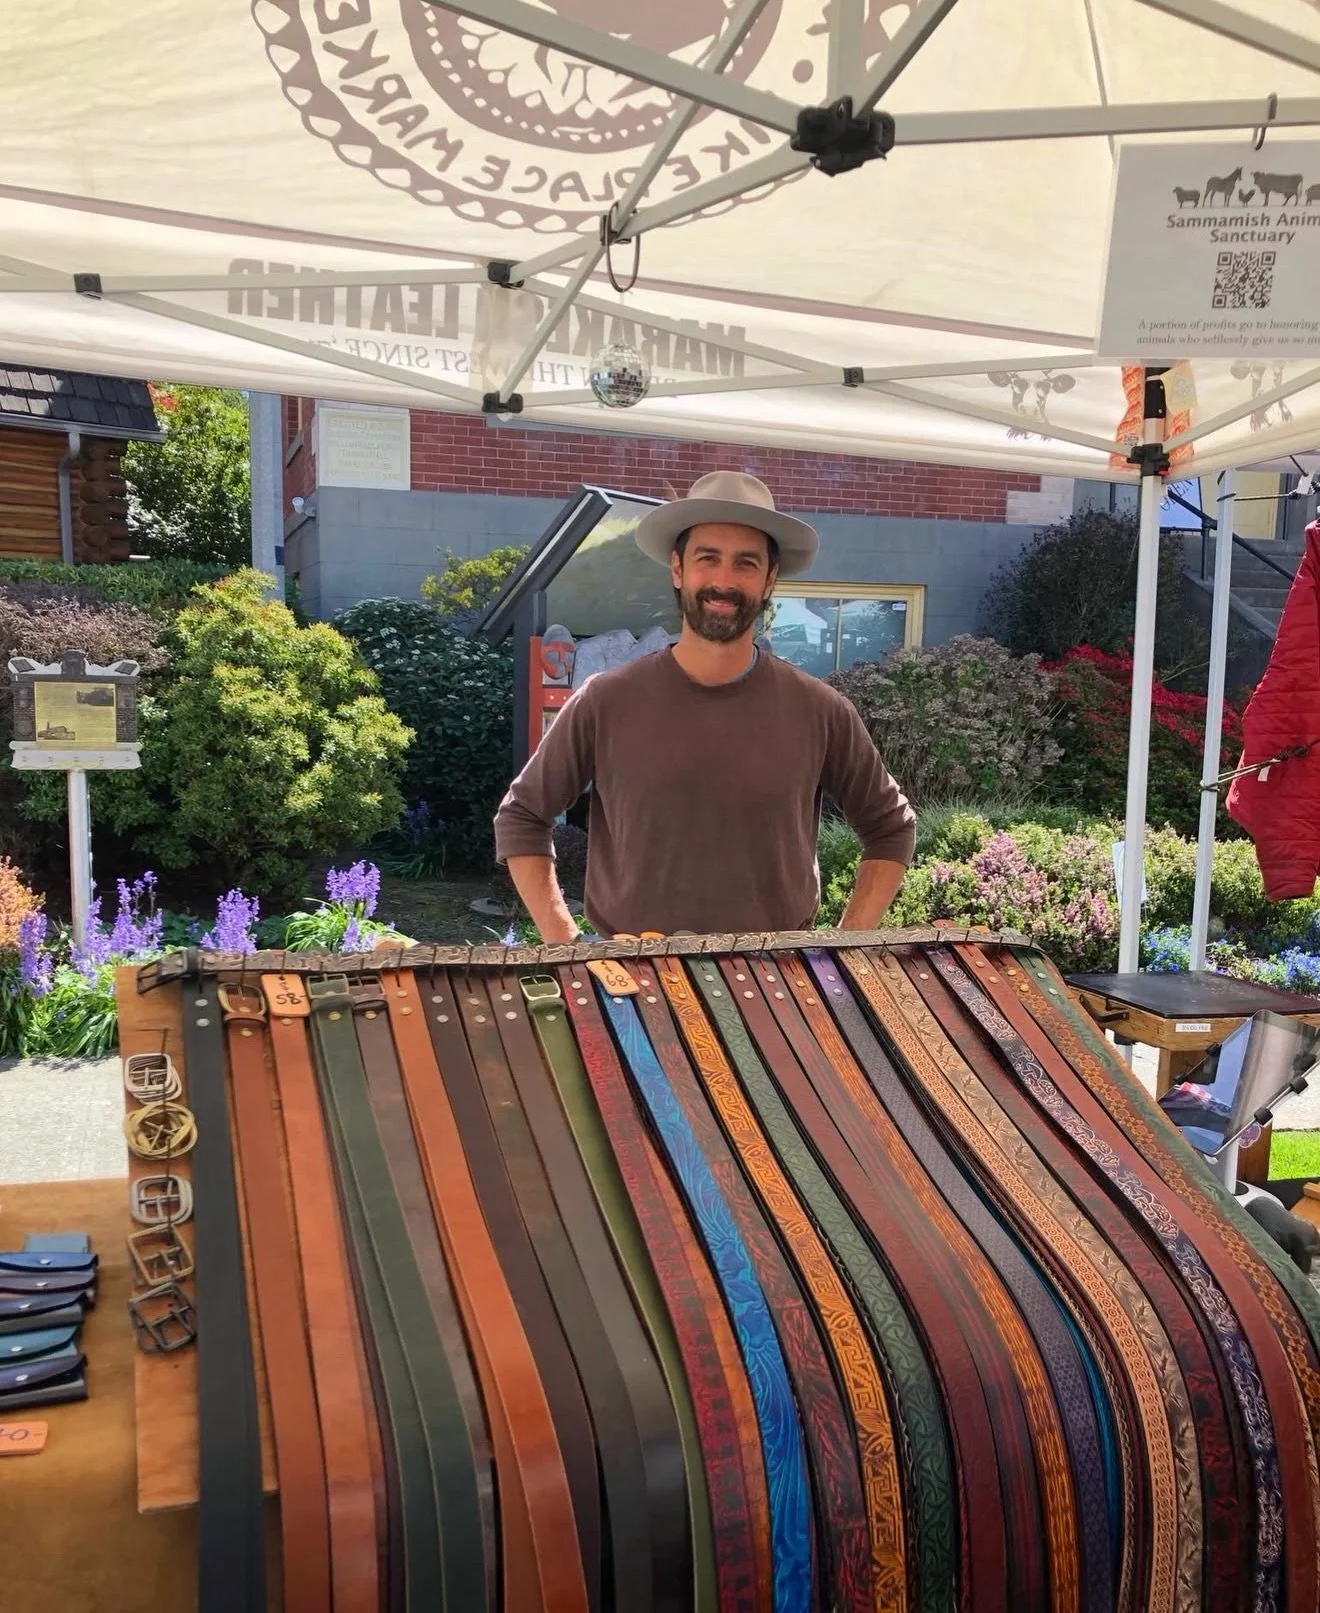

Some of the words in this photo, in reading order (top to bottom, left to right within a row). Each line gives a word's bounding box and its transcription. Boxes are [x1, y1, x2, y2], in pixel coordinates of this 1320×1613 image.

[1167, 212, 1270, 228] Sammamish
[1210, 229, 1296, 245] Sanctuary
[1149, 319, 1187, 333] portion
[1189, 319, 1202, 330] of
[1202, 319, 1237, 332] profits
[1239, 322, 1253, 332] go
[1256, 320, 1267, 329] to
[1269, 318, 1319, 332] honoring
[1136, 334, 1175, 344] animals
[1178, 333, 1200, 344] who
[1251, 335, 1273, 347] give
[1277, 336, 1289, 344] us
